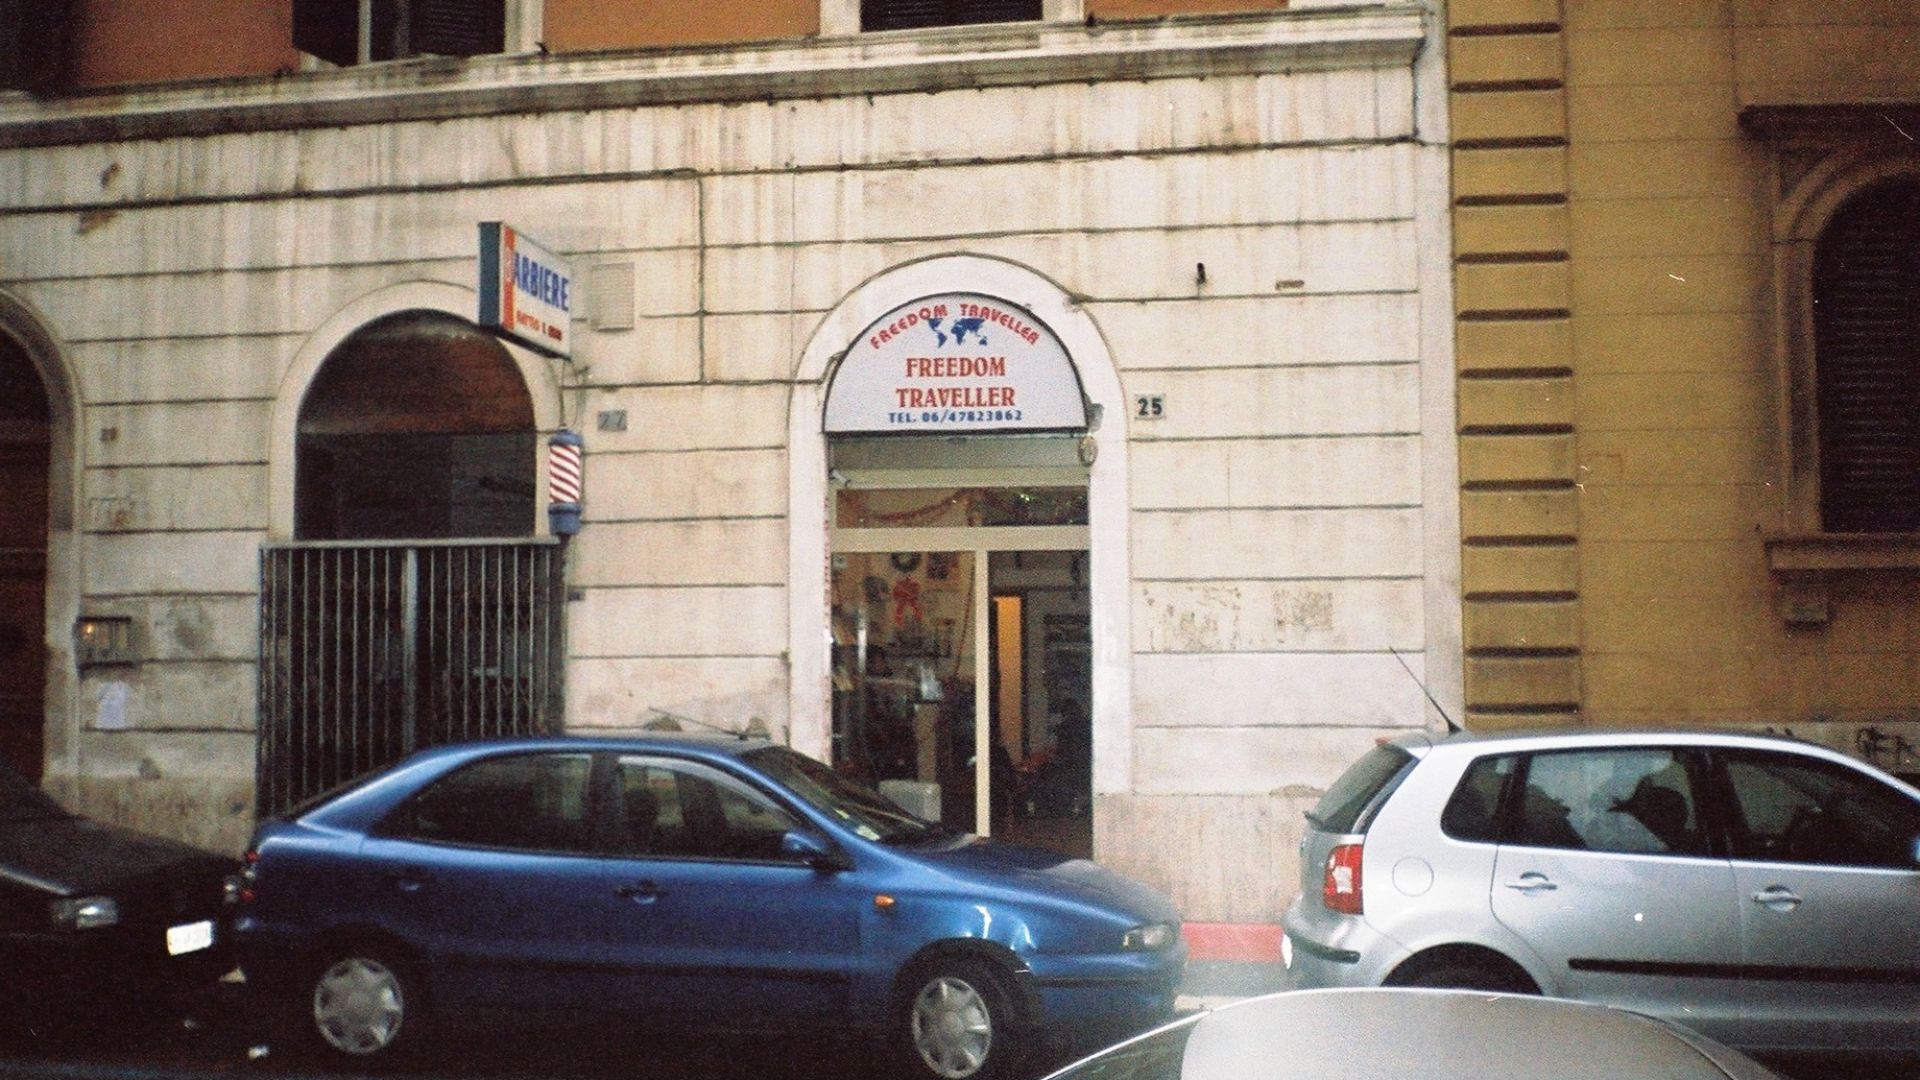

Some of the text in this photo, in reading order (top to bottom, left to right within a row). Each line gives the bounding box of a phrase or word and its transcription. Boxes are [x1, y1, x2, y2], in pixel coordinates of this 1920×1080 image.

[870, 304, 1039, 349] FREEDOM TRAVELLER
[906, 357, 1006, 377] FREEDOM
[896, 387, 1016, 408] TRAVELLER
[1138, 397, 1163, 416] 25
[888, 412, 917, 423] TEL.
